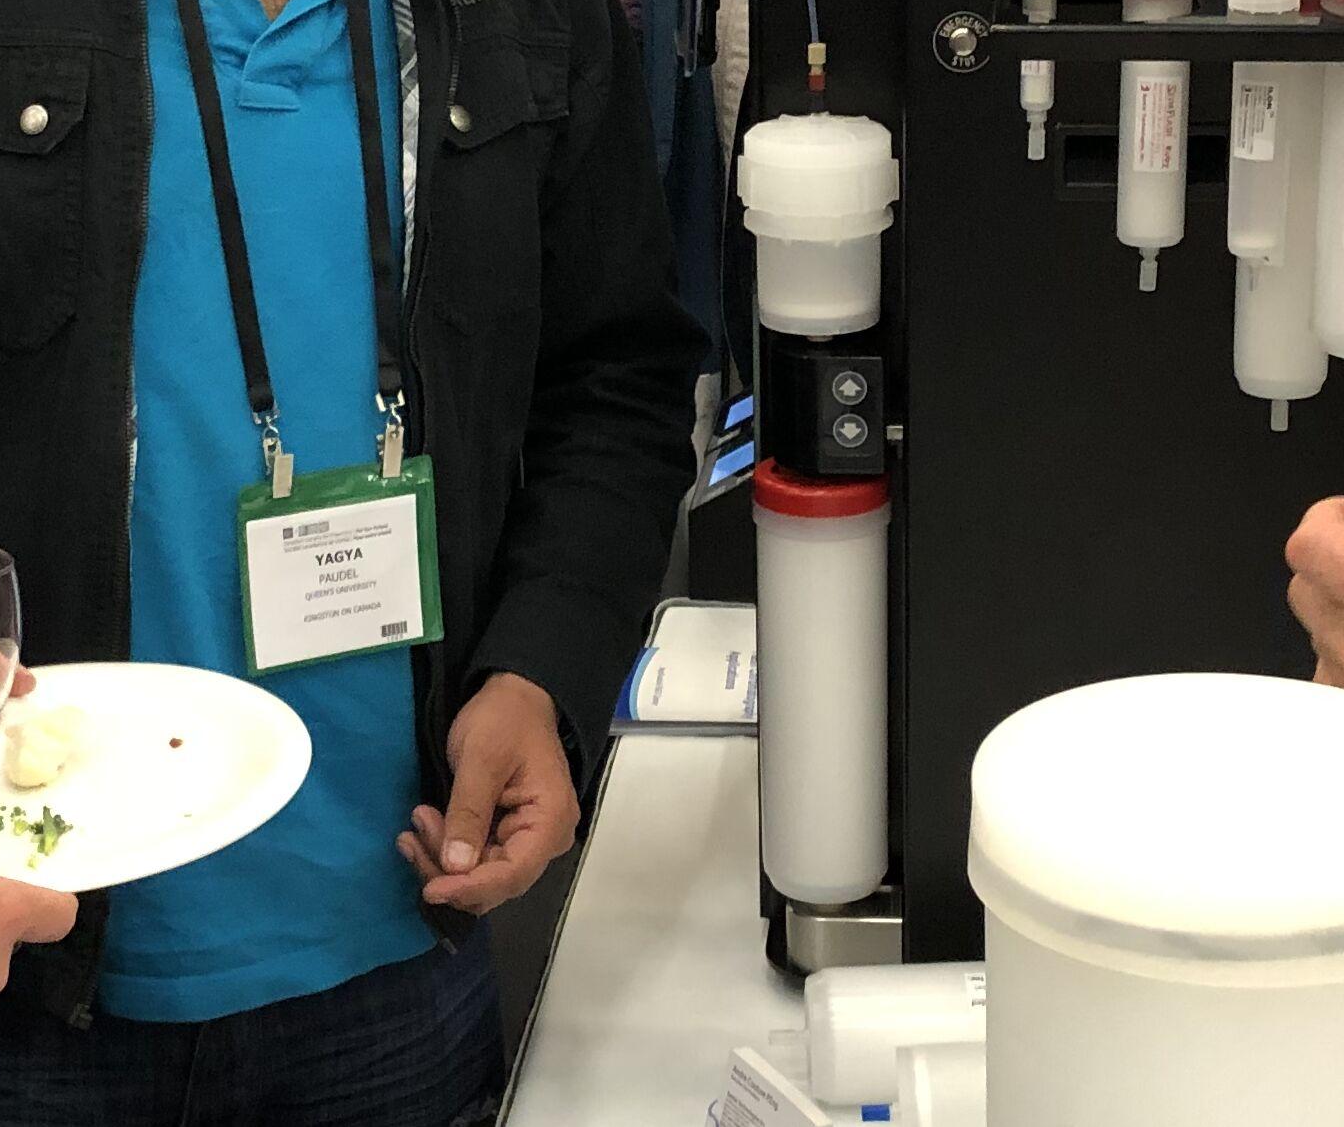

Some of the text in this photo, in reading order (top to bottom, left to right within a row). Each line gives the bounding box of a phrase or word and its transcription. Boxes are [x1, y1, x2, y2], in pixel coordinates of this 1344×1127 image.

[939, 16, 989, 38] EMERGENCY
[951, 55, 976, 68] STOP
[314, 547, 364, 567] YAGYA
[318, 568, 360, 585] PAUDEL
